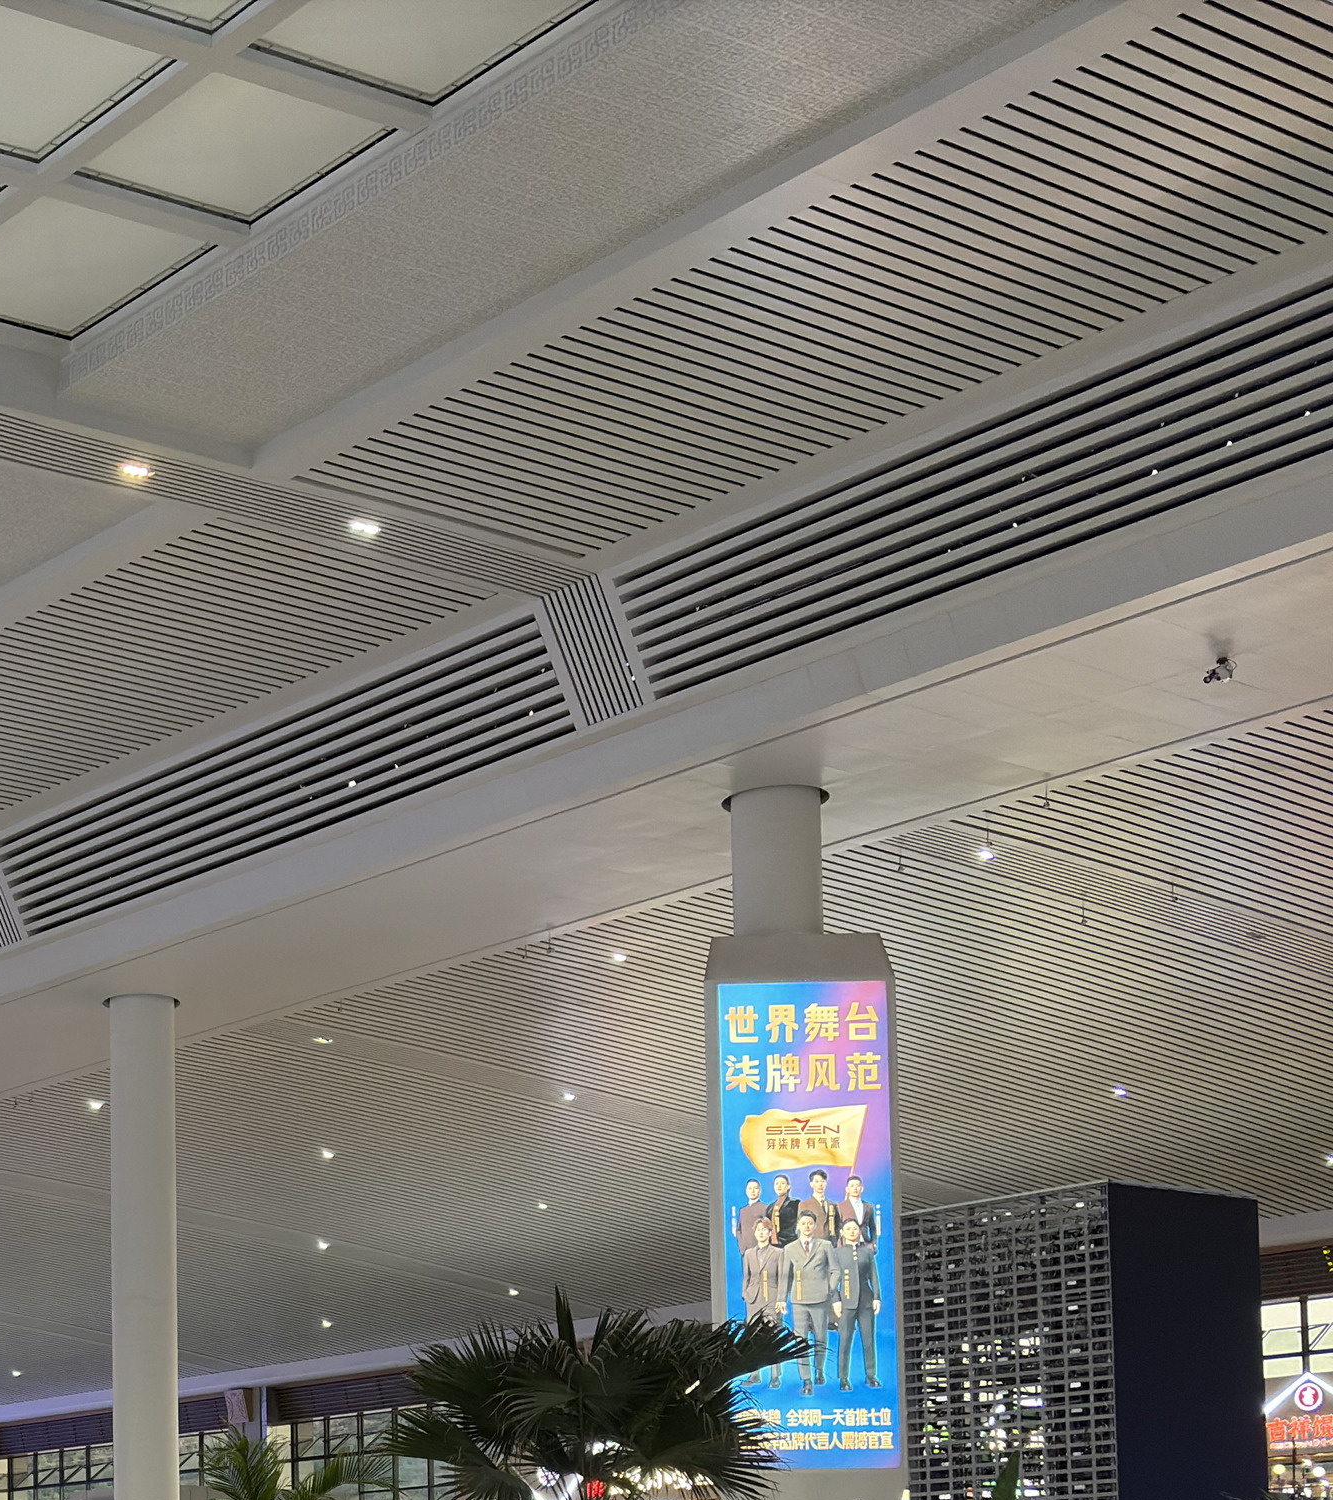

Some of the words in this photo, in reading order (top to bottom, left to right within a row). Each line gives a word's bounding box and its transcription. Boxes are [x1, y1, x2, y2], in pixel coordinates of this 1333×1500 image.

[724, 1001, 880, 1044] 世界舞台
[724, 1052, 883, 1093] 柒牌风范
